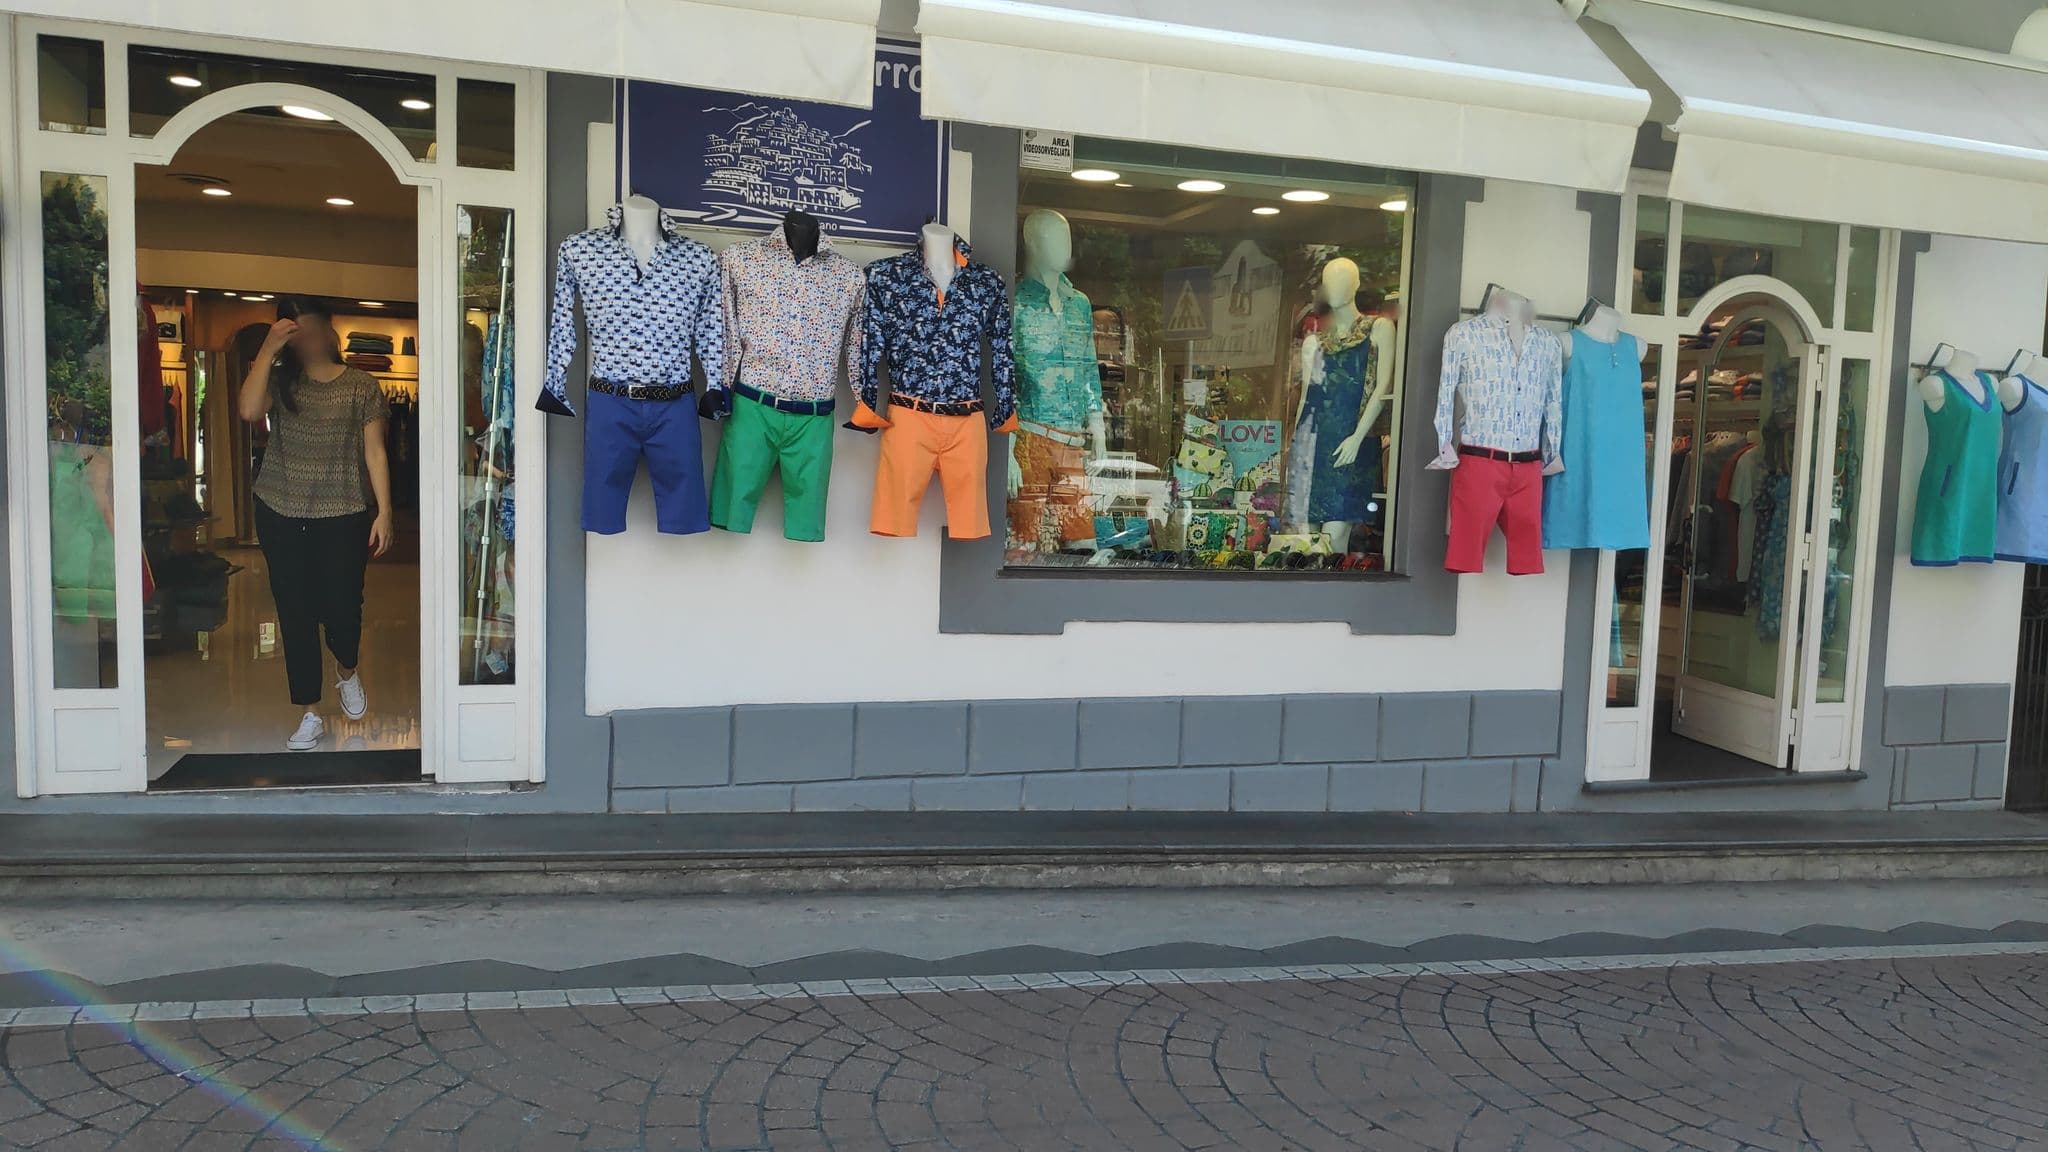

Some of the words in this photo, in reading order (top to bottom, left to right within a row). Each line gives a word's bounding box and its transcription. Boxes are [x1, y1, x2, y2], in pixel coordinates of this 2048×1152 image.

[1052, 137, 1070, 147] AREA
[1023, 143, 1070, 157] VIDEOSORVEGLIATA
[1220, 424, 1276, 443] LOVE
